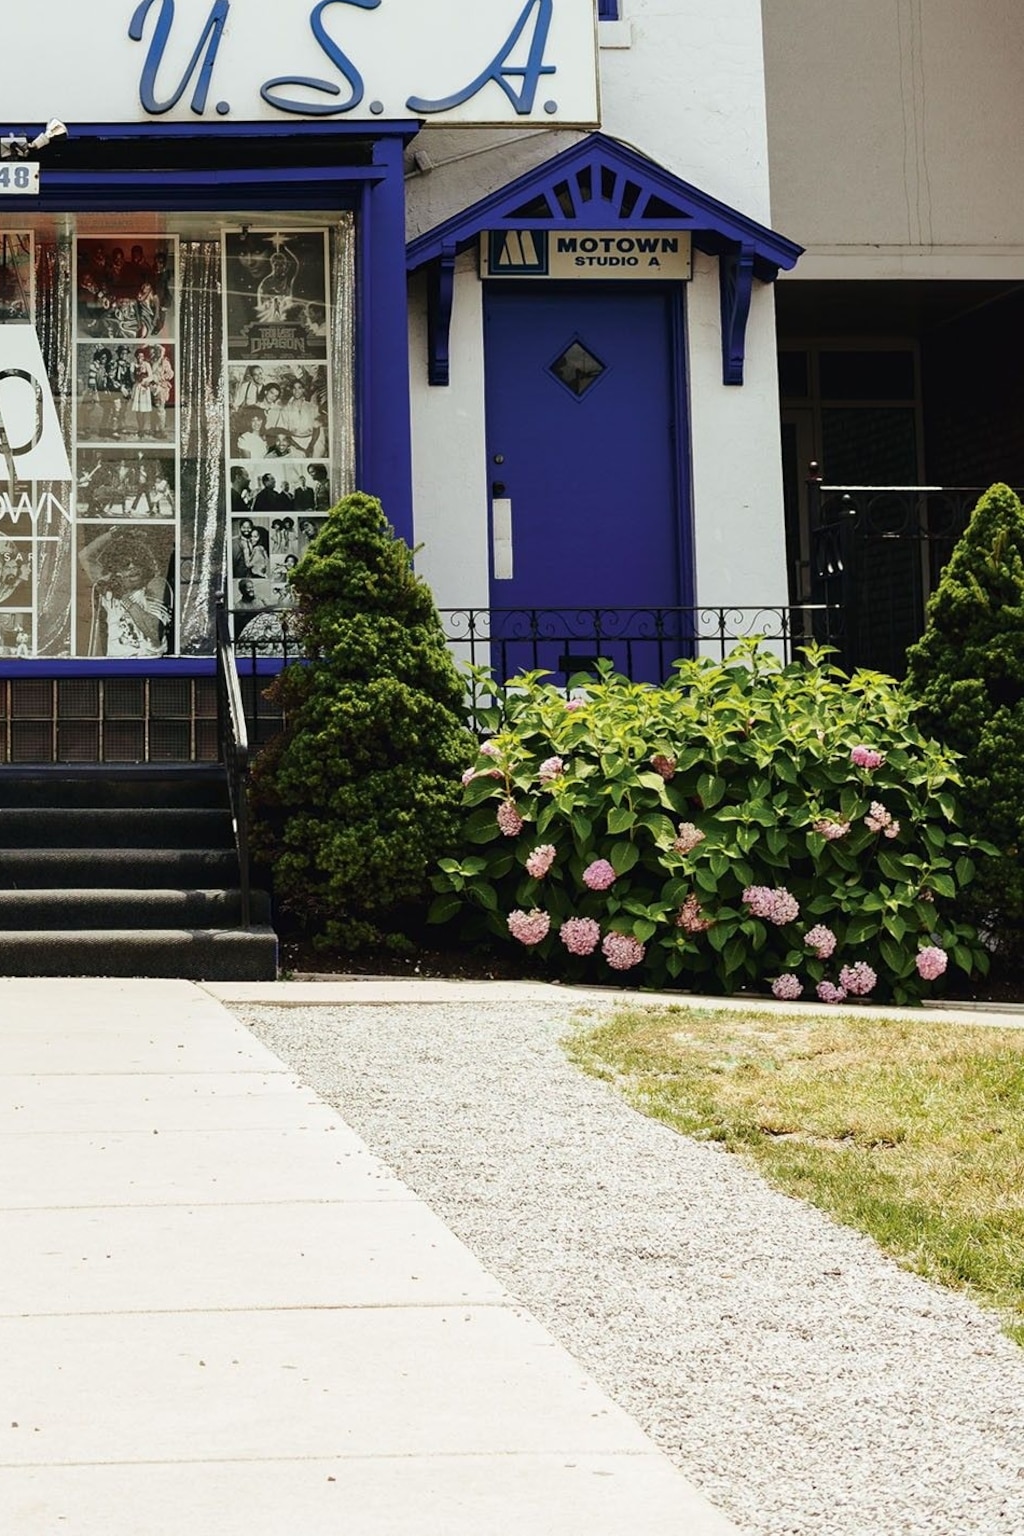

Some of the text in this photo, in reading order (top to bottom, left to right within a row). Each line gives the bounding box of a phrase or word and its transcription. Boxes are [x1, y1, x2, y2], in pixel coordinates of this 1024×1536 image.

[557, 238, 679, 253] MOTOWN
[574, 256, 661, 267] STUDIO A
